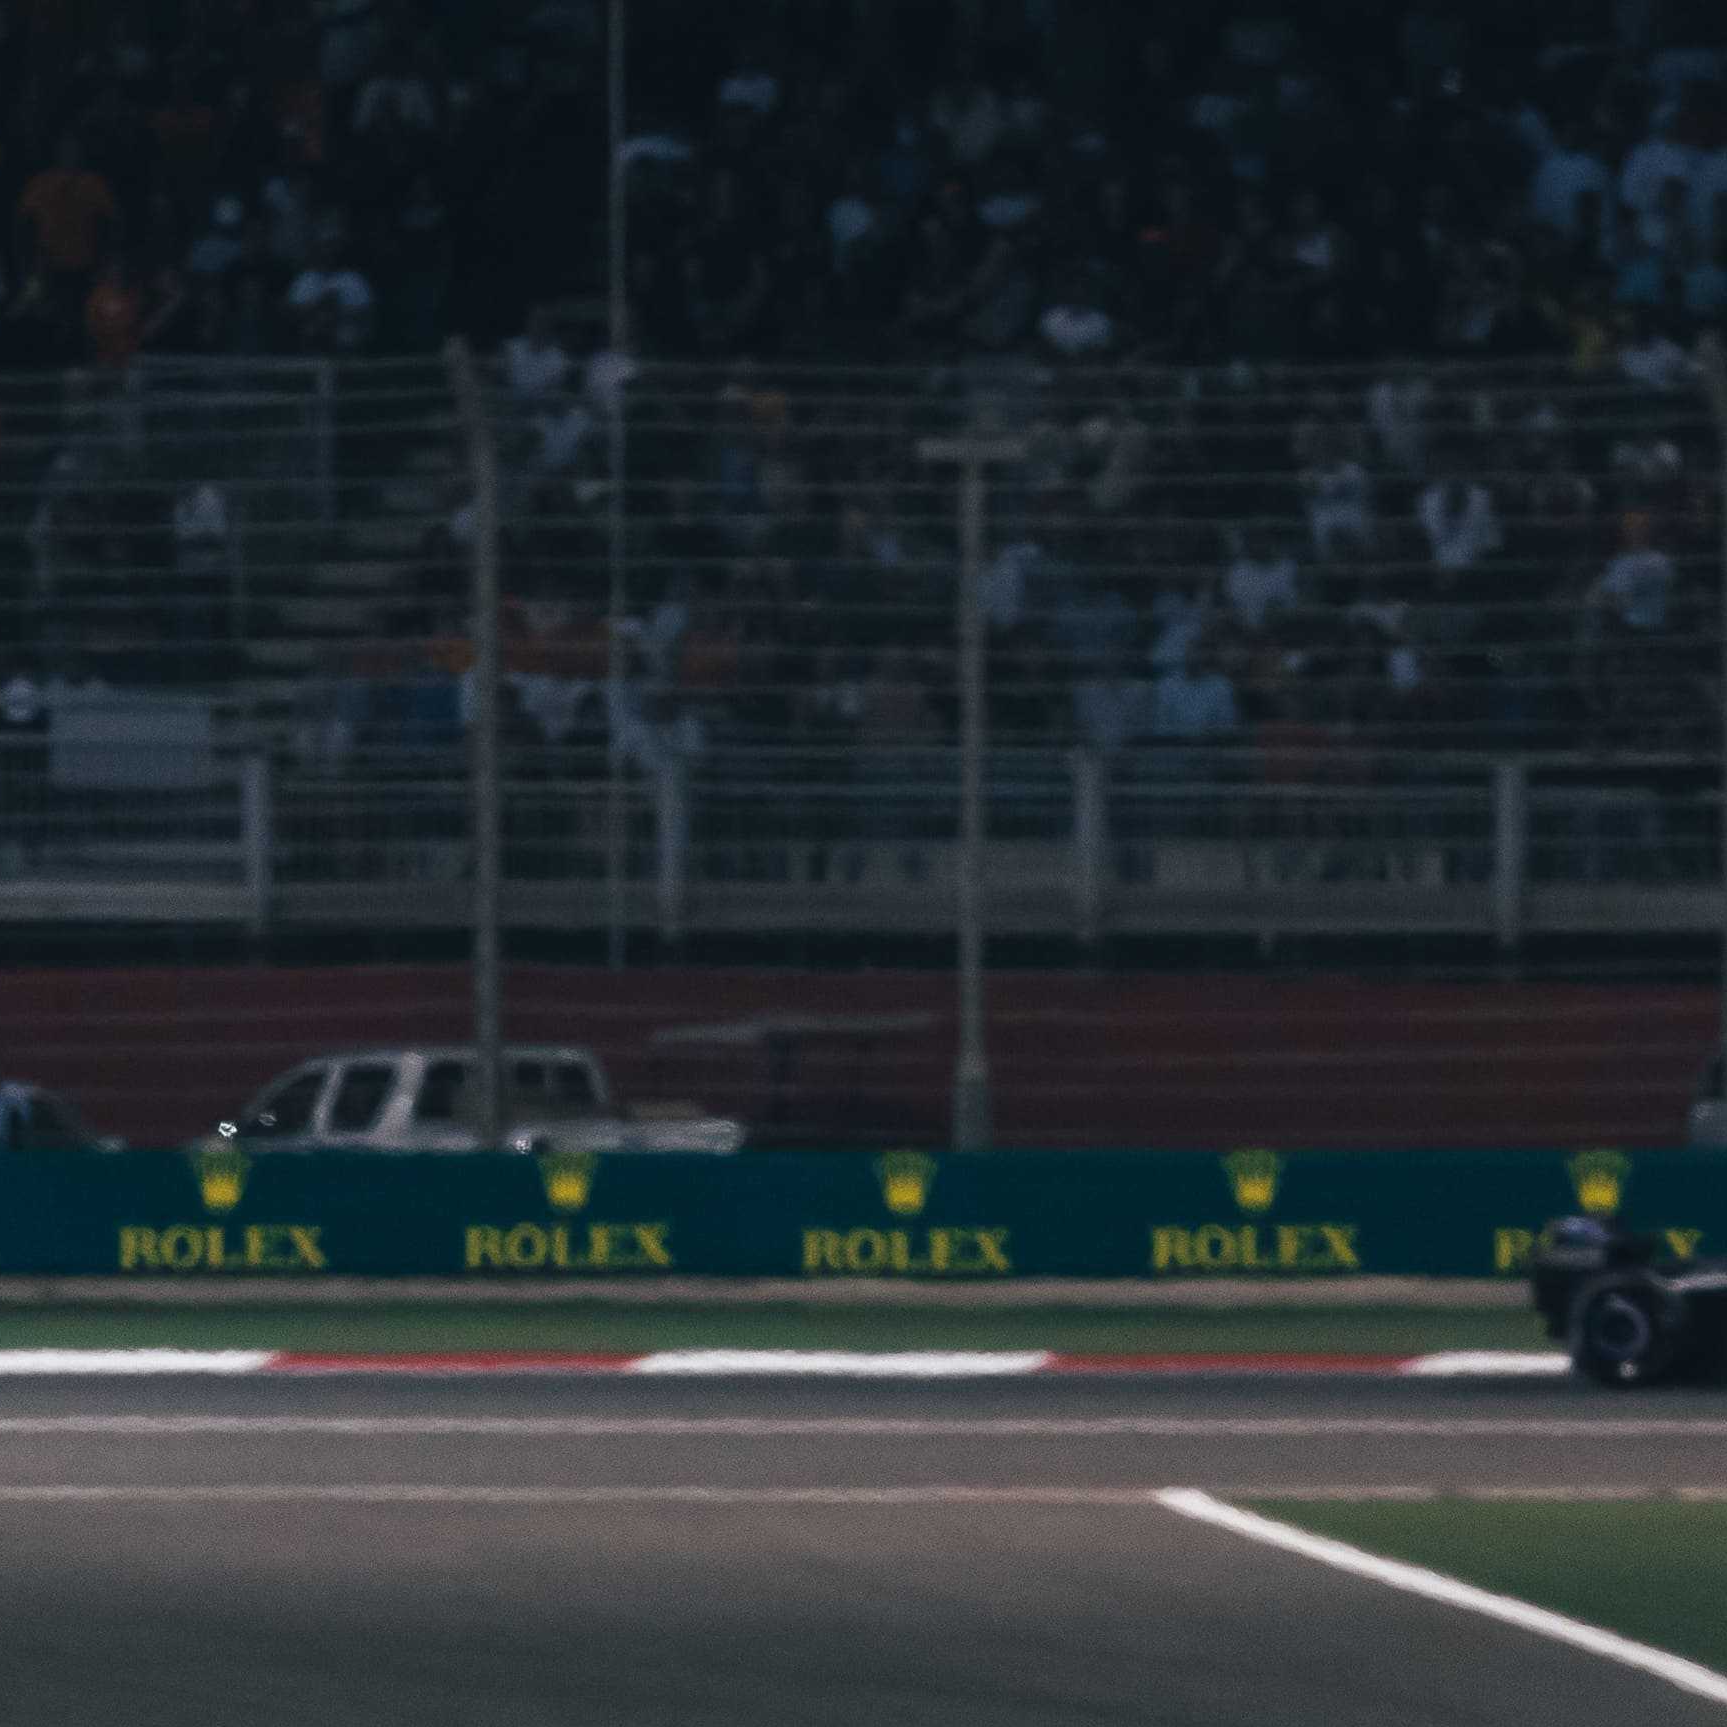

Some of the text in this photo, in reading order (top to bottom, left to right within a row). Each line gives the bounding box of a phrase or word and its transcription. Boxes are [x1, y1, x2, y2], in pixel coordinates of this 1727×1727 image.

[120, 1225, 324, 1268] ROLEX
[465, 1223, 670, 1267] ROLEX
[802, 1228, 1010, 1270] ROLEX
[1152, 1223, 1359, 1268] ROLEX
